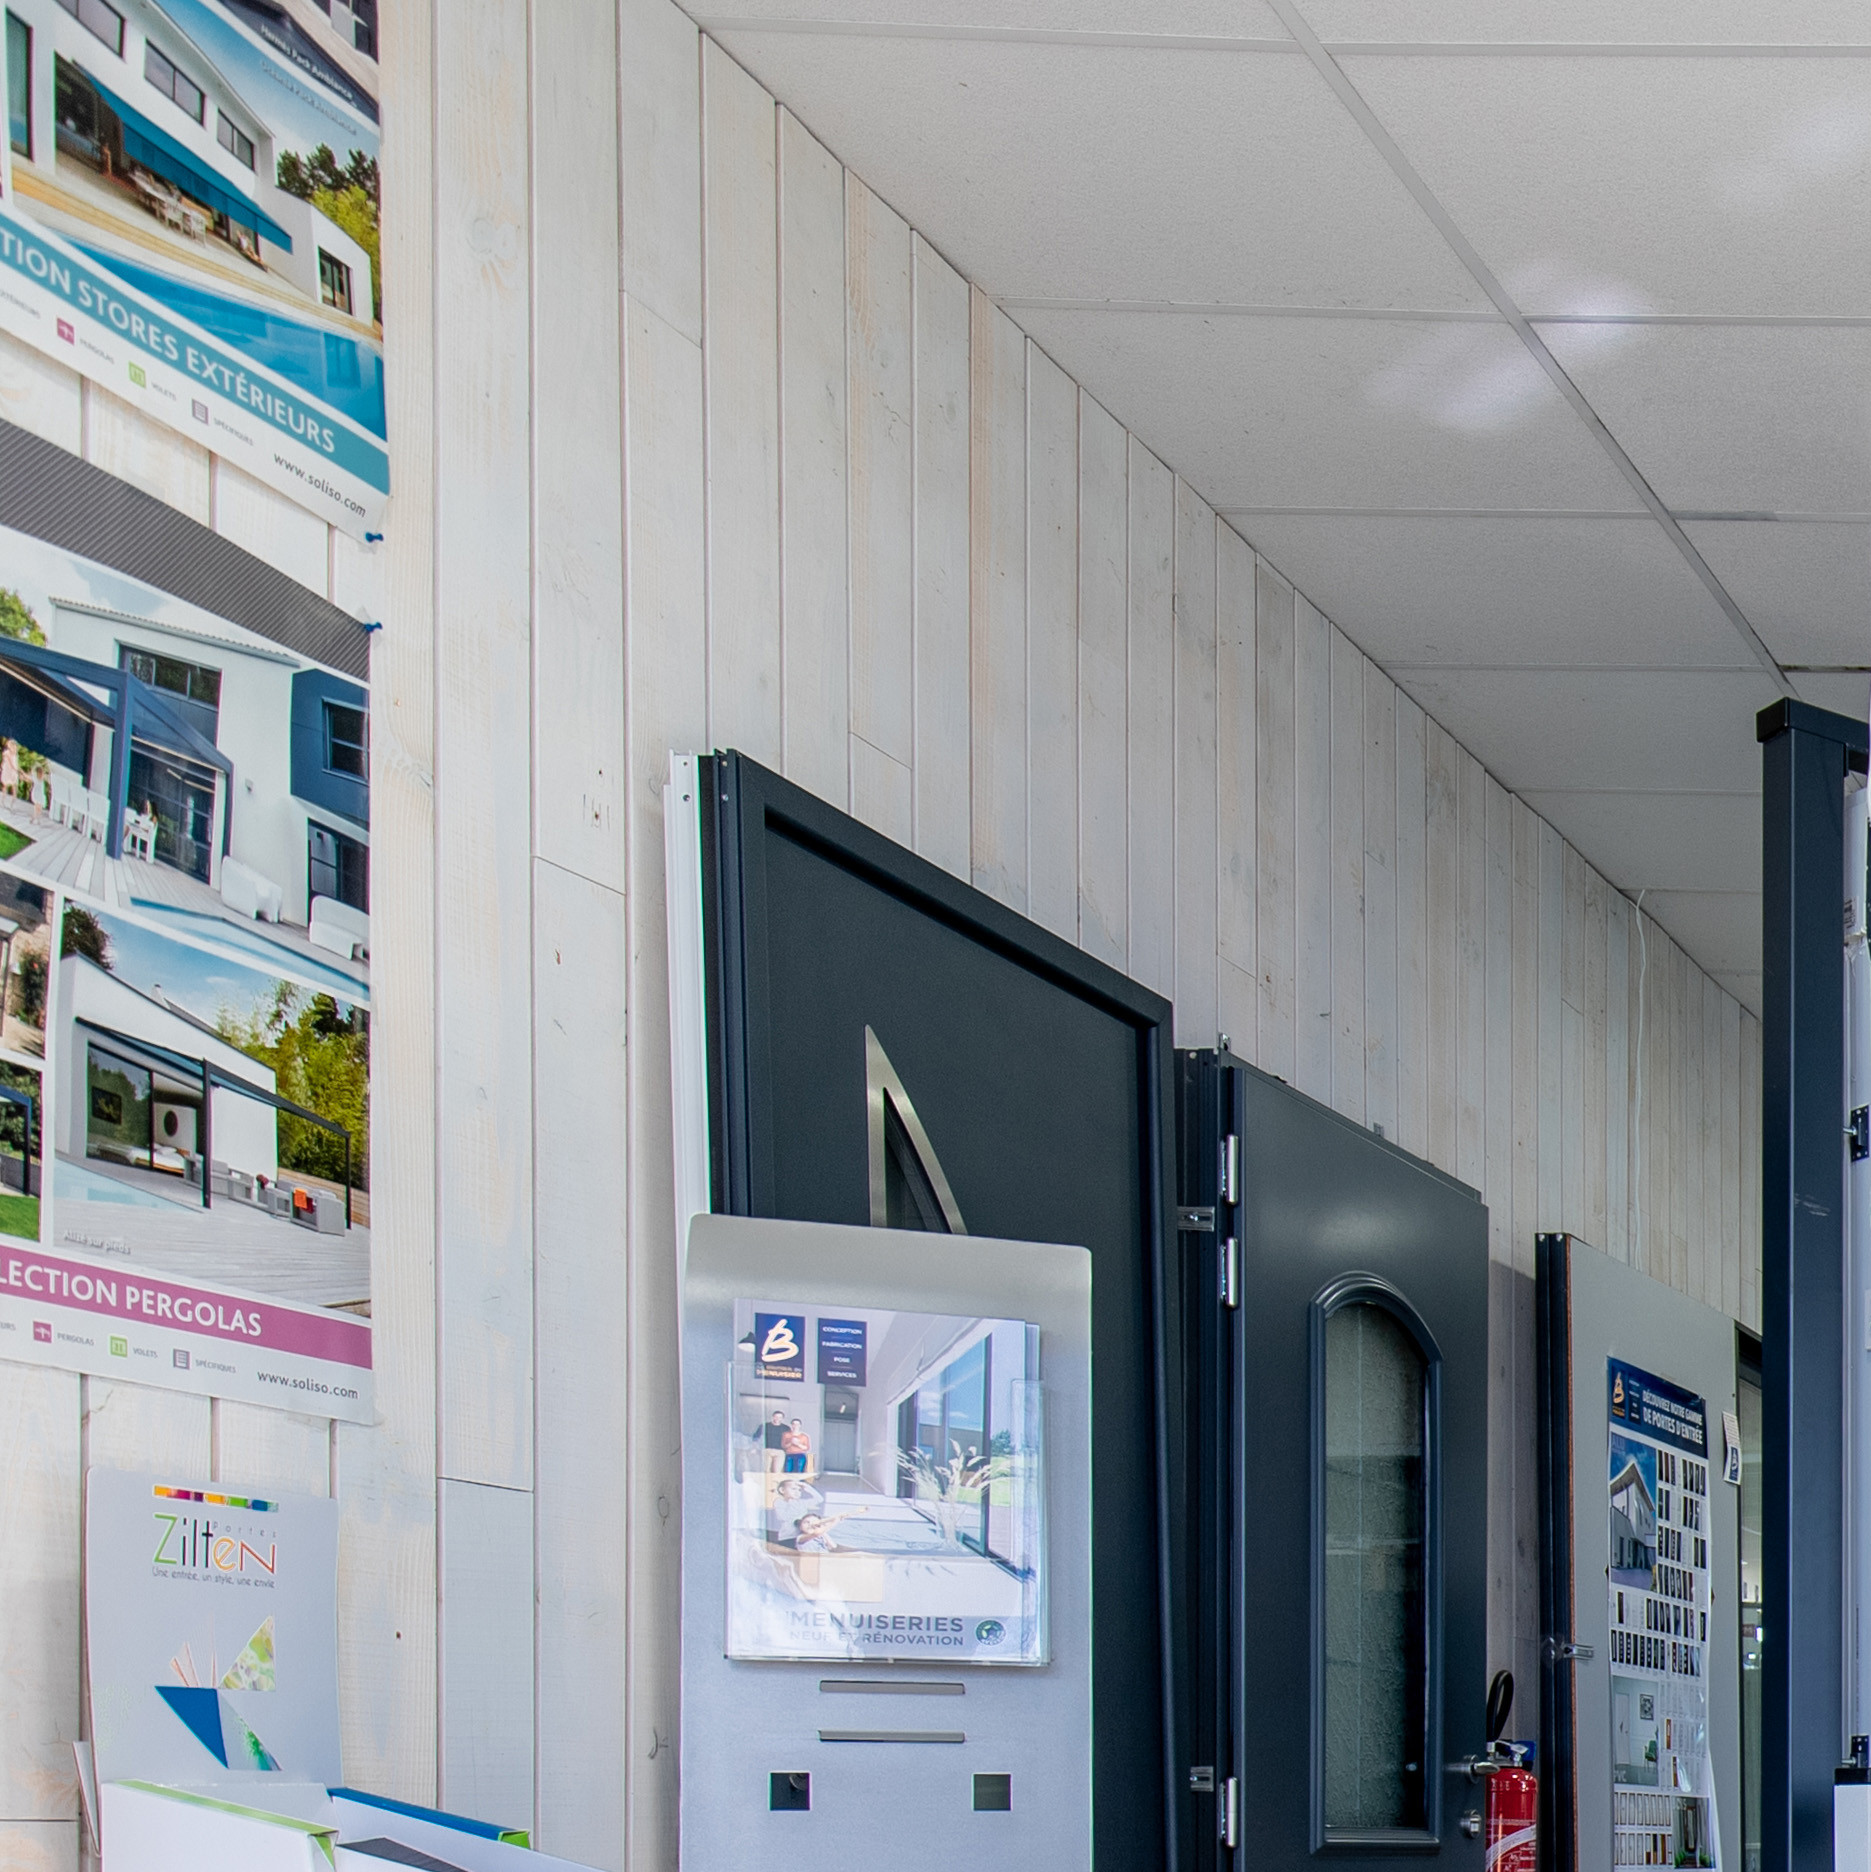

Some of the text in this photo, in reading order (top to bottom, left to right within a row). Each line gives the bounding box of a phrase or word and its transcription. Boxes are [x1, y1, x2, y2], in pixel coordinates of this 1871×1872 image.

[78, 279, 179, 361] STORES
[186, 344, 336, 454] EXTÉRIEURS
[273, 452, 367, 519] www.soliso.com
[125, 1284, 263, 1337] PERGOLAS
[57, 1331, 95, 1347] PERGOLAS
[822, 1326, 863, 1335] CONCEPTION
[132, 1346, 159, 1359] VOLETS
[195, 1358, 237, 1375] SPÉCIFIQUES
[826, 1370, 857, 1379] SERVICES
[256, 1370, 360, 1401] www.soliso.com
[1642, 1407, 1652, 1424] DE
[1651, 1409, 1676, 1434] PORTES
[790, 1611, 965, 1633] MENUISERIES
[862, 1629, 965, 1647] RÉNOVATION
